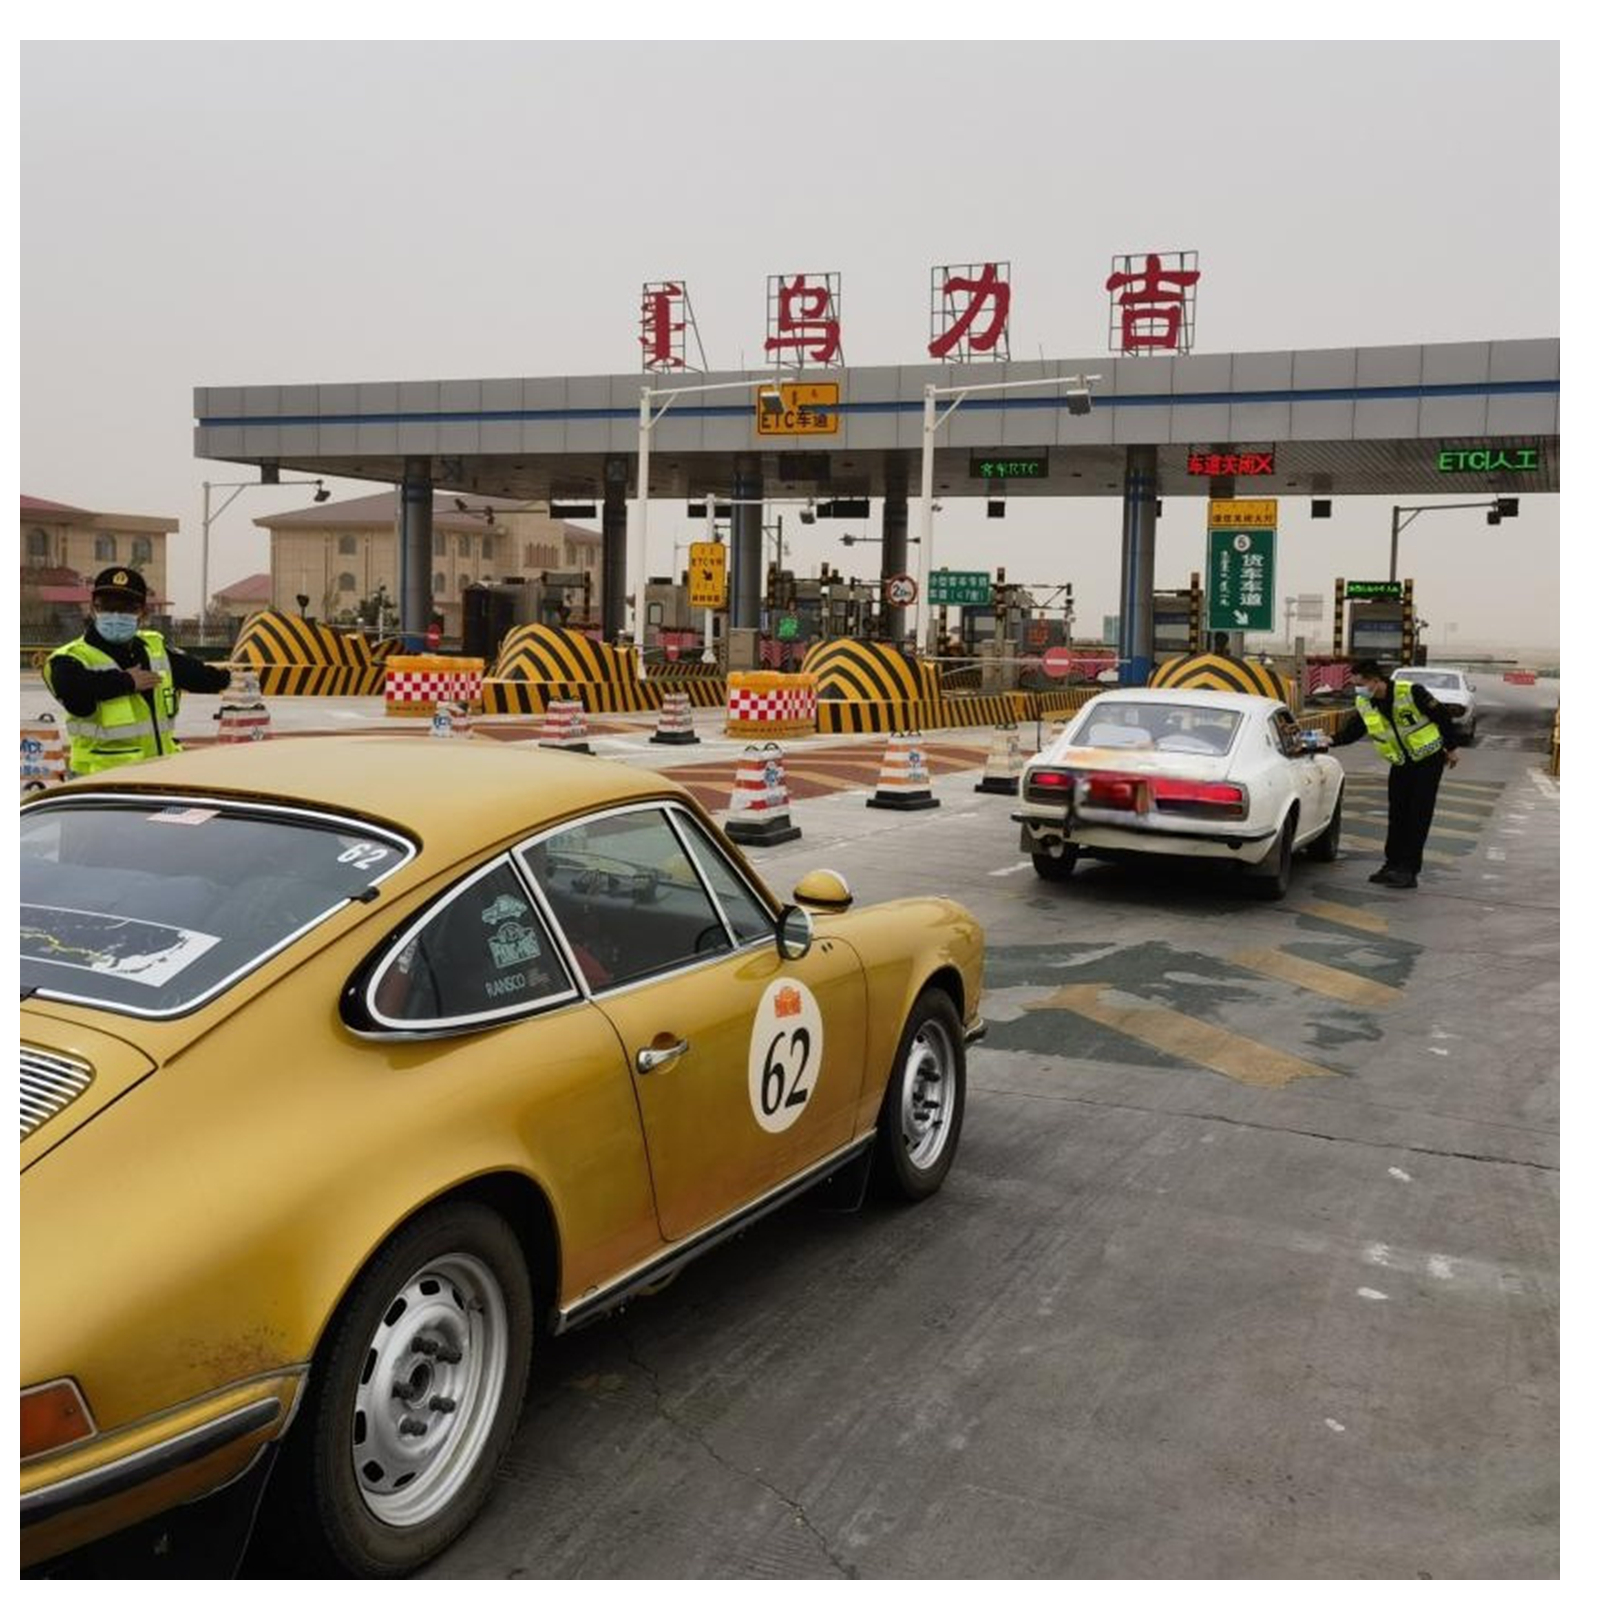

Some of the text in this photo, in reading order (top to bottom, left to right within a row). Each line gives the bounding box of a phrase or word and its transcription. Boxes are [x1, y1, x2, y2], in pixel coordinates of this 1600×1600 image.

[1240, 554, 1264, 606] 货车车道
[337, 842, 388, 871] 62
[761, 1027, 810, 1116] 62
